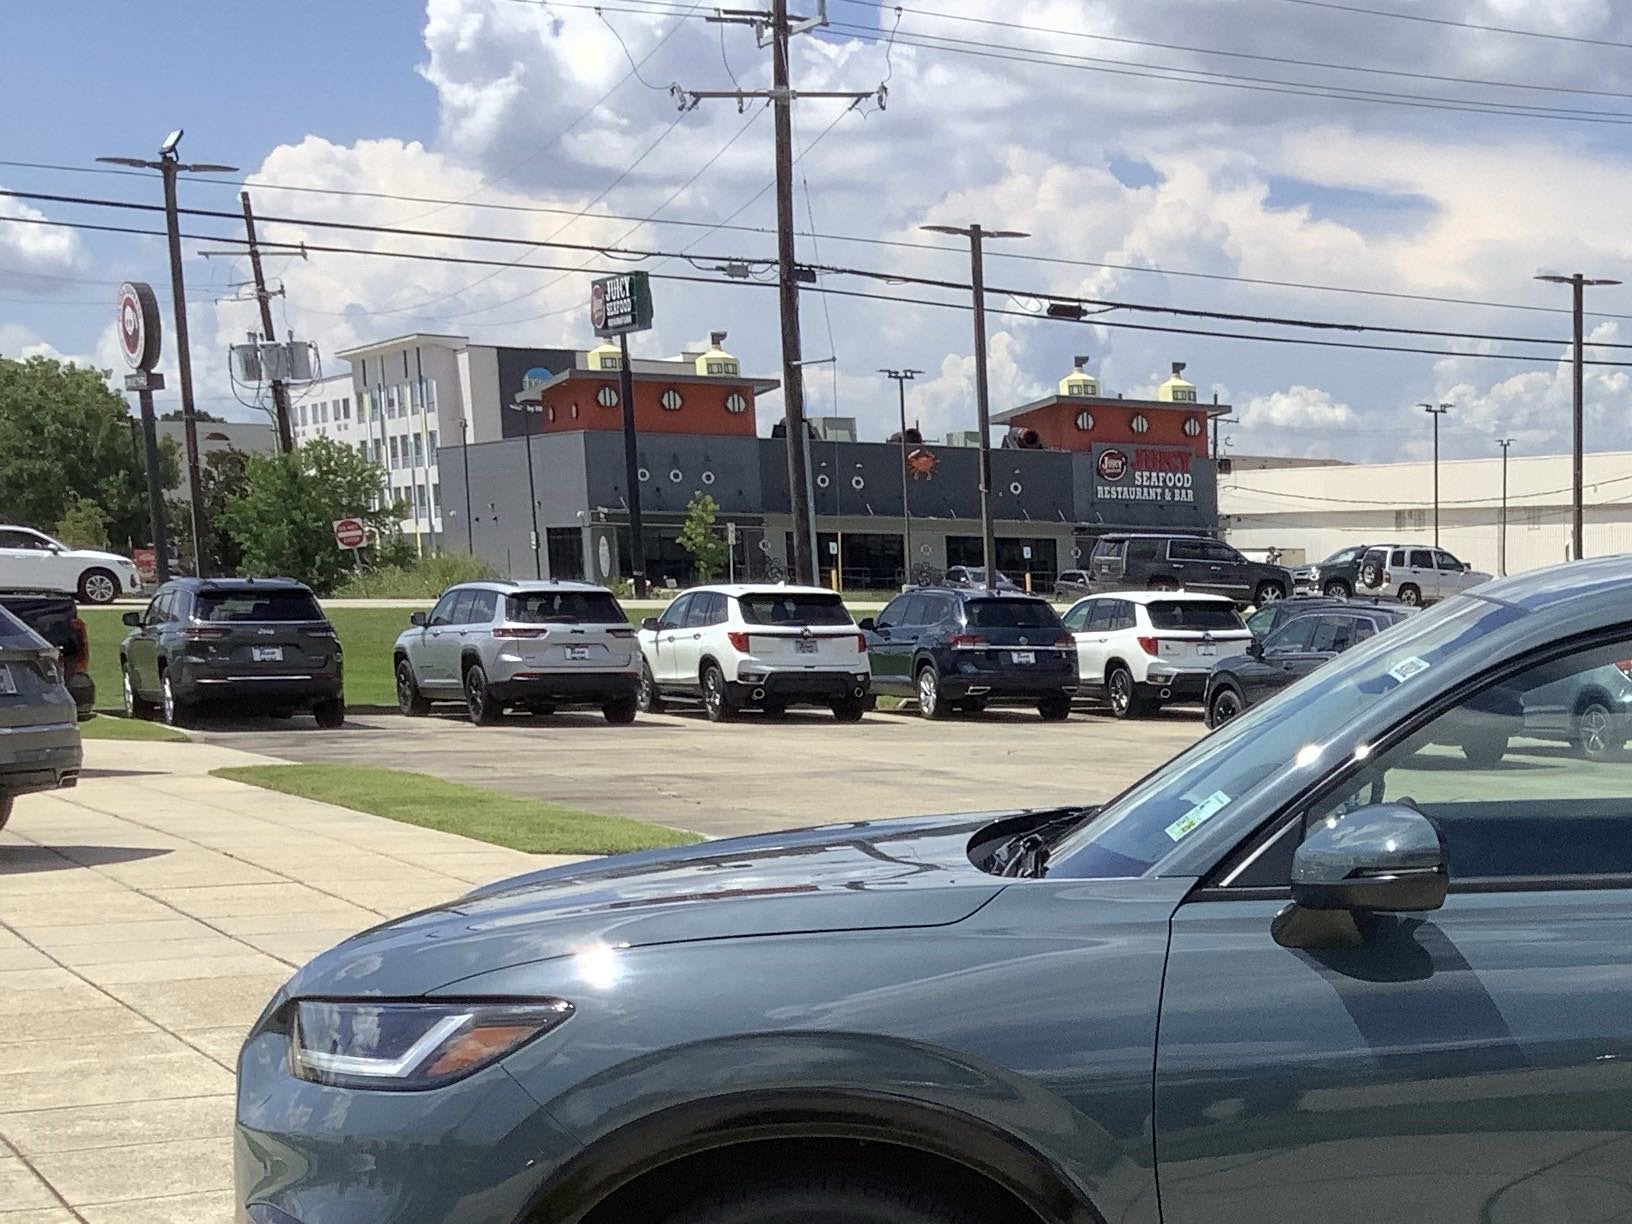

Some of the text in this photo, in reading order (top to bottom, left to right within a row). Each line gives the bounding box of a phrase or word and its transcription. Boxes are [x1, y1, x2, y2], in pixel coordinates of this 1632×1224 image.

[605, 276, 630, 301] JUICY
[1134, 471, 1192, 487] SEAFOOD
[1097, 486, 1194, 502] RESTAURANT & BAR
